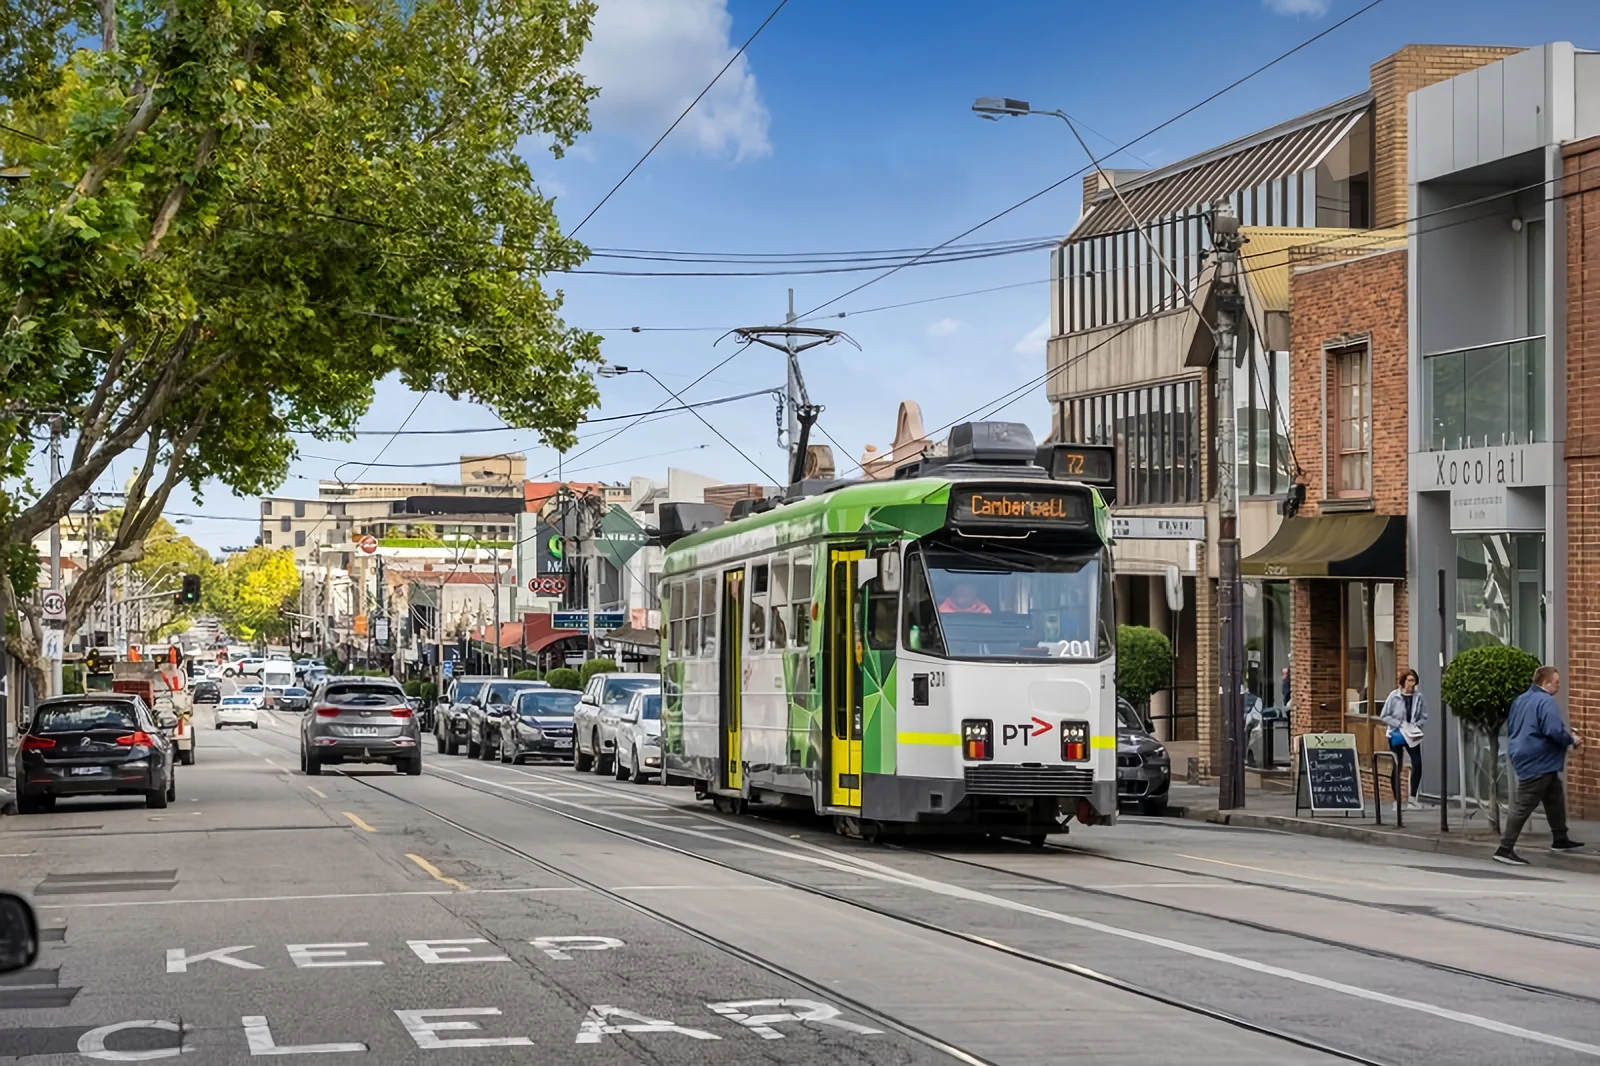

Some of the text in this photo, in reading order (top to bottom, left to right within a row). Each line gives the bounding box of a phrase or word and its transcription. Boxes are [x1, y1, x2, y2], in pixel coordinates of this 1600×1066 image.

[1066, 454, 1085, 475] 72
[971, 495, 1067, 518] Camberwell
[46, 598, 62, 610] 40
[1058, 639, 1092, 658] 201
[164, 935, 625, 975] KEEP
[77, 997, 885, 1061] CLEAR
